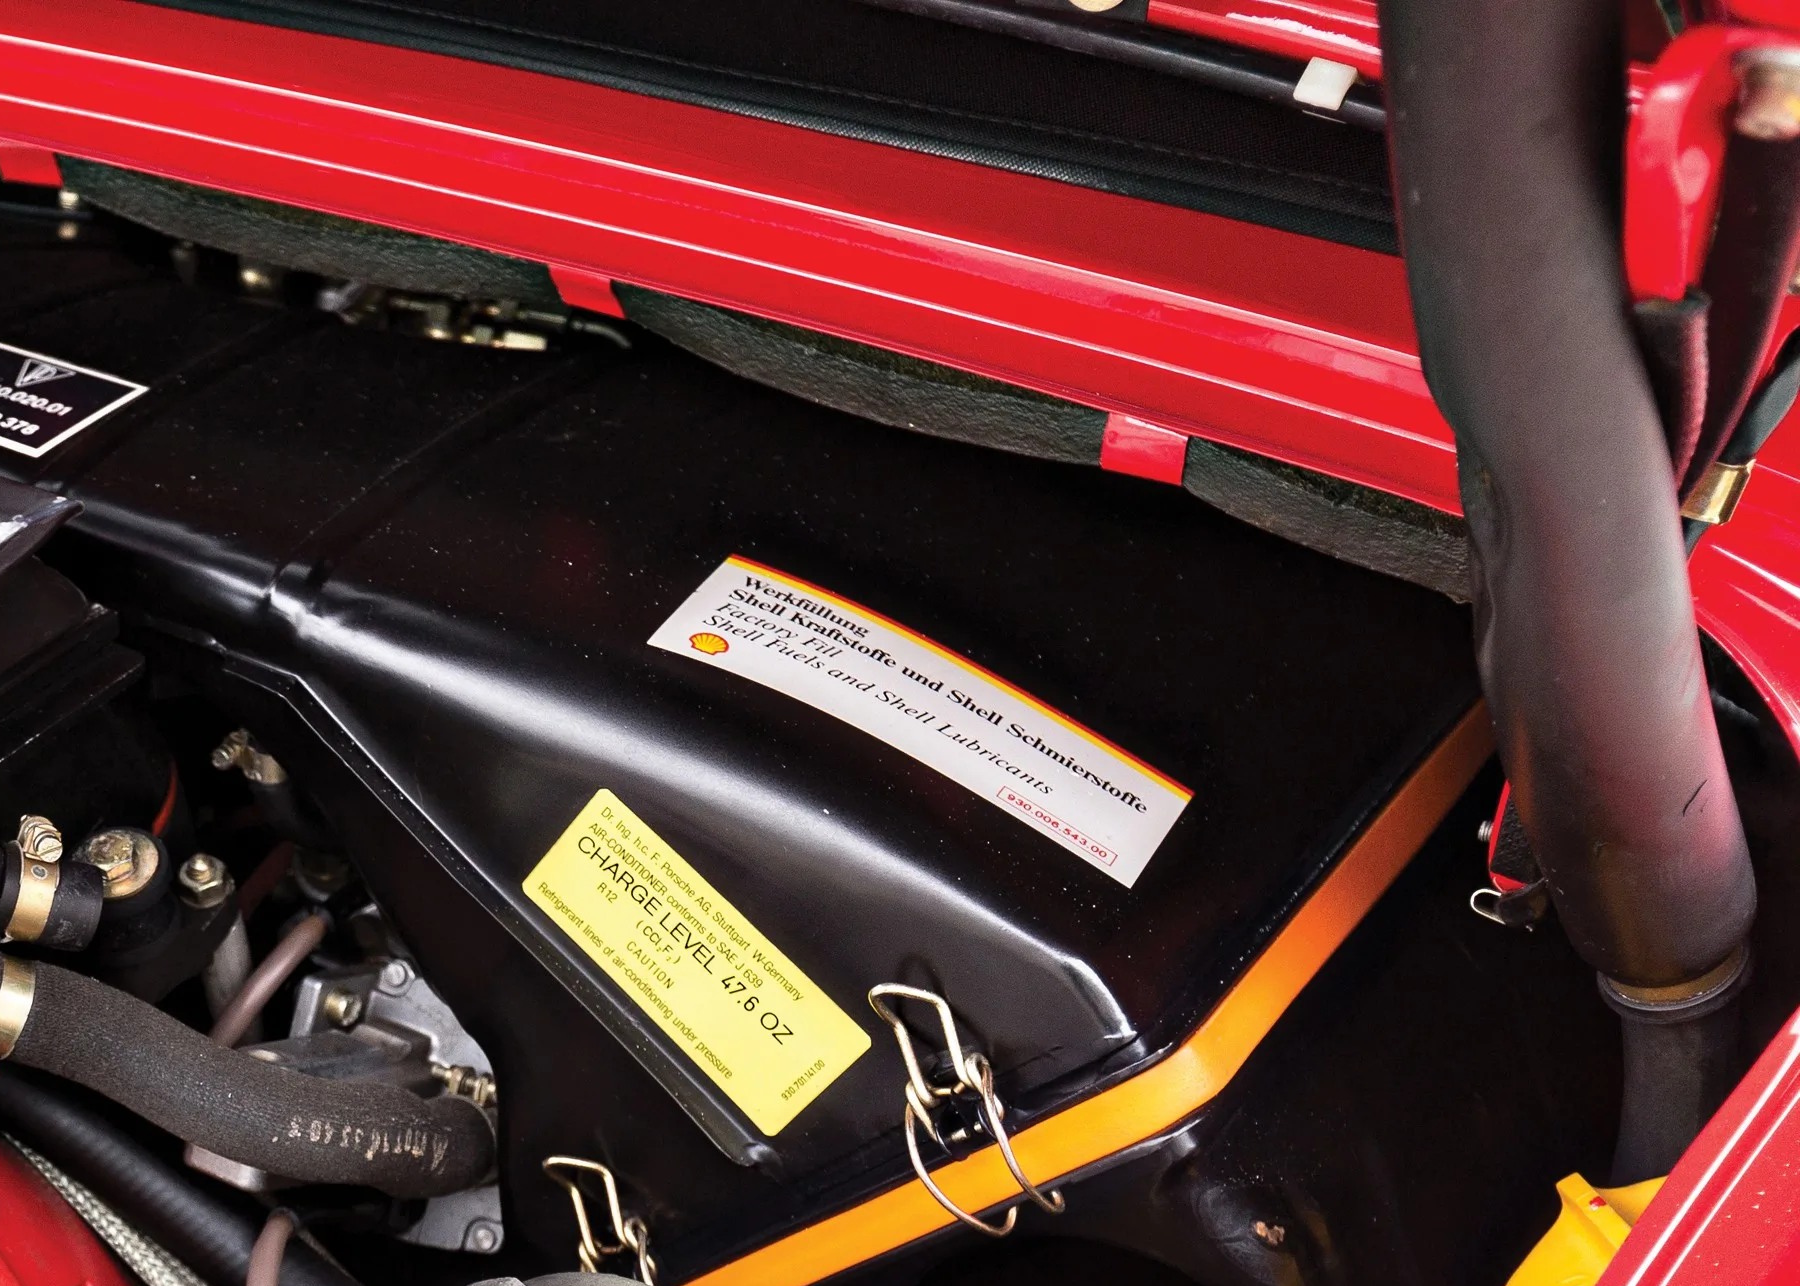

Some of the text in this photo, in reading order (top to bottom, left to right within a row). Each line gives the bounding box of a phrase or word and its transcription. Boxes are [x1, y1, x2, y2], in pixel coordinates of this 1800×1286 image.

[0, 417, 40, 435] 378
[715, 602, 843, 658] Factory Fill
[745, 576, 869, 638] Werkfüllung
[702, 614, 1054, 796] Shell Fuels and Shell Lubricants
[729, 588, 1148, 814] Shell Kraftstoffe und Shell Schmierstoffe
[1006, 793, 1108, 859] 930.006.543.00
[577, 835, 795, 1046] CHARGE LEVEL 47.6 OZ
[588, 822, 764, 989] AIR-CONDITIONER conforms to SAE J 639
[600, 806, 804, 1002] Dr. Ing. h.c. F. Porsche AG, Stuttgart W-Germany
[538, 881, 733, 1080] Refrigerant lines of air-conditioning under pressure
[626, 940, 675, 990] CAUTION
[780, 1059, 826, 1101] 930.701.141.00
